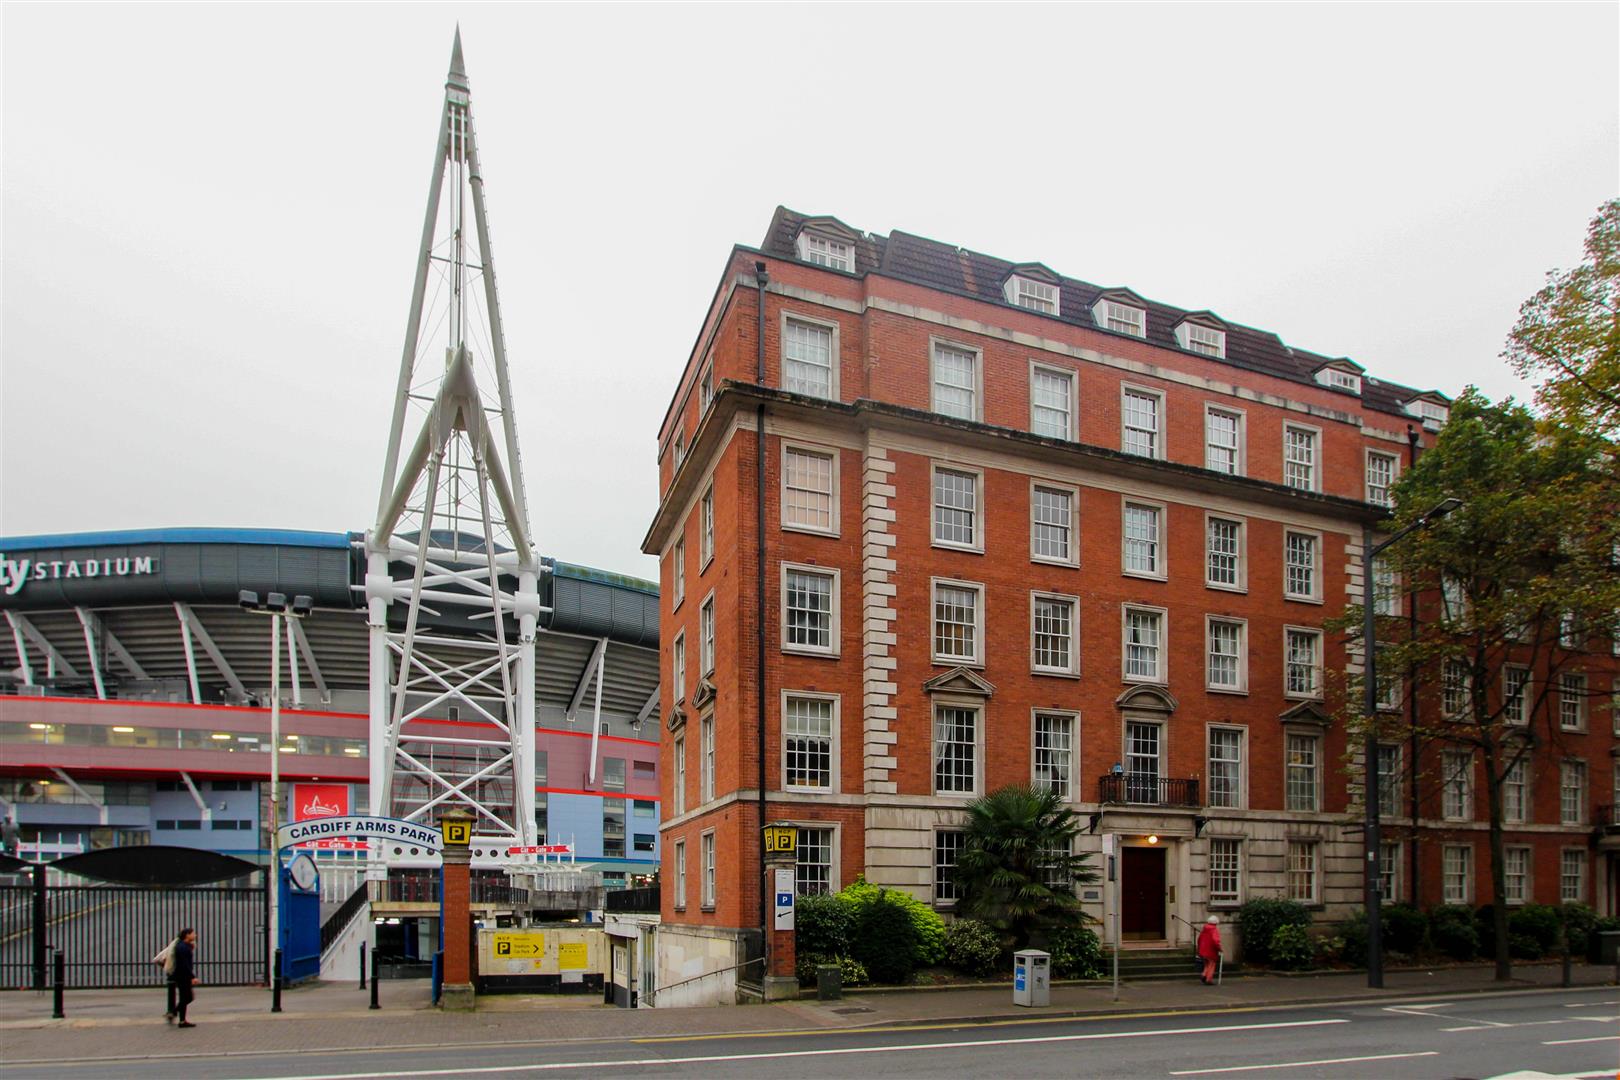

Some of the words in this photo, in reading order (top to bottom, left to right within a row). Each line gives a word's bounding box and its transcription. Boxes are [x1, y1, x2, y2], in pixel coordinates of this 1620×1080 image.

[35, 556, 152, 580] STADIUM
[290, 821, 352, 839] CARDIFF
[355, 821, 396, 834] ARMS
[400, 826, 437, 845] PARK
[451, 827, 462, 840] P
[351, 841, 356, 849] 2
[780, 836, 789, 848] P
[782, 896, 788, 904] P
[499, 943, 509, 954] P
